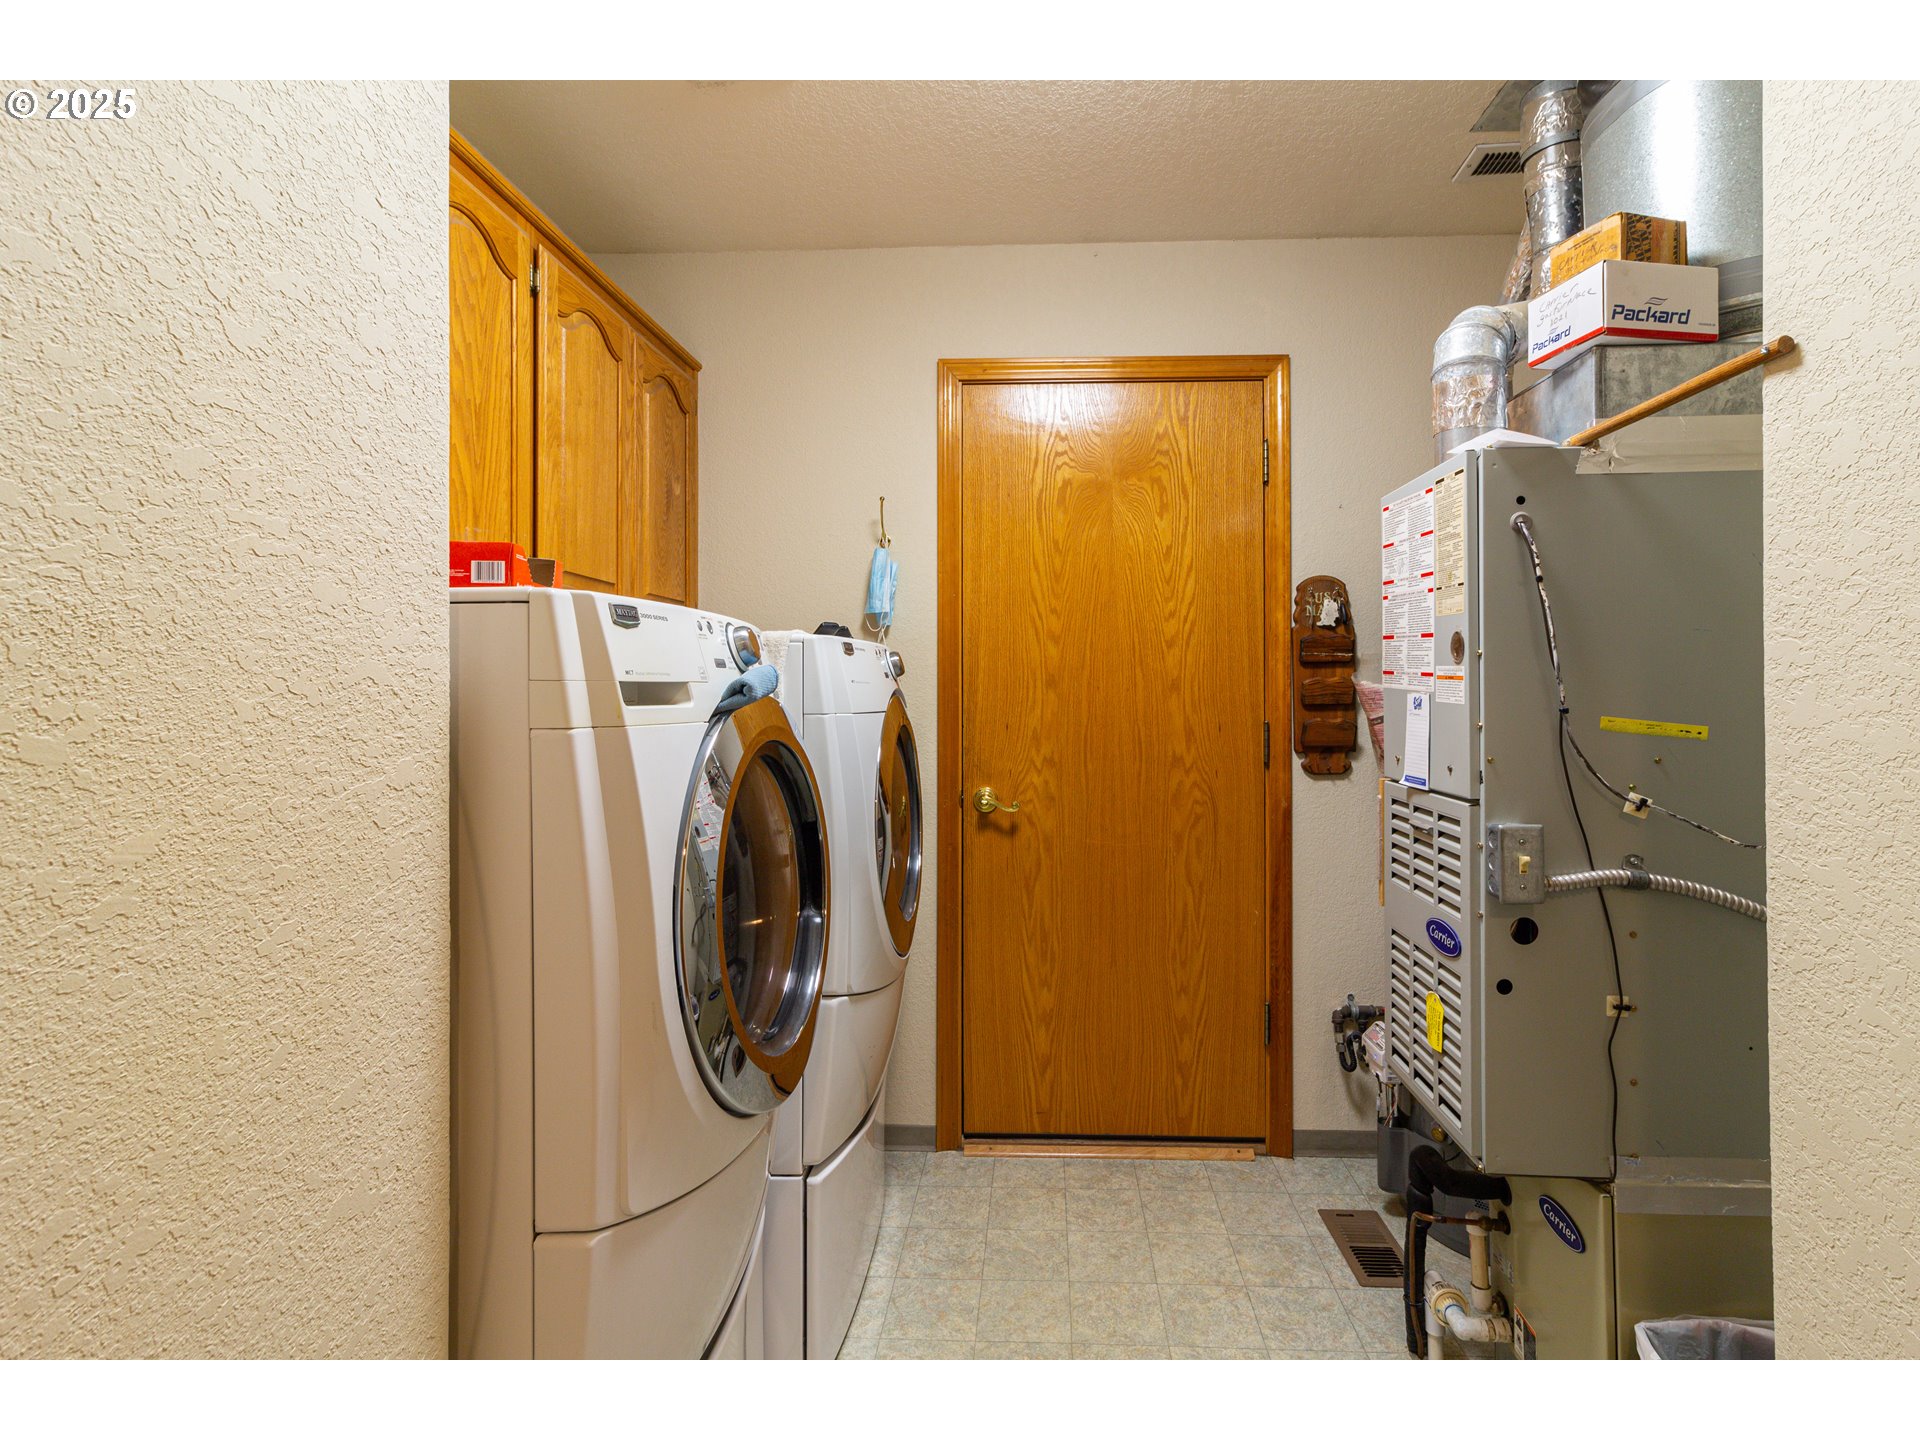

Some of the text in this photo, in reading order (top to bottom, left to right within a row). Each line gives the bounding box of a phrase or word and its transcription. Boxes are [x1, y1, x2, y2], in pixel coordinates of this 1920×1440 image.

[1611, 304, 1691, 325] Packard
[1531, 325, 1572, 354] Packard
[1429, 924, 1455, 949] Carrier
[1543, 1203, 1577, 1242] Carrier
